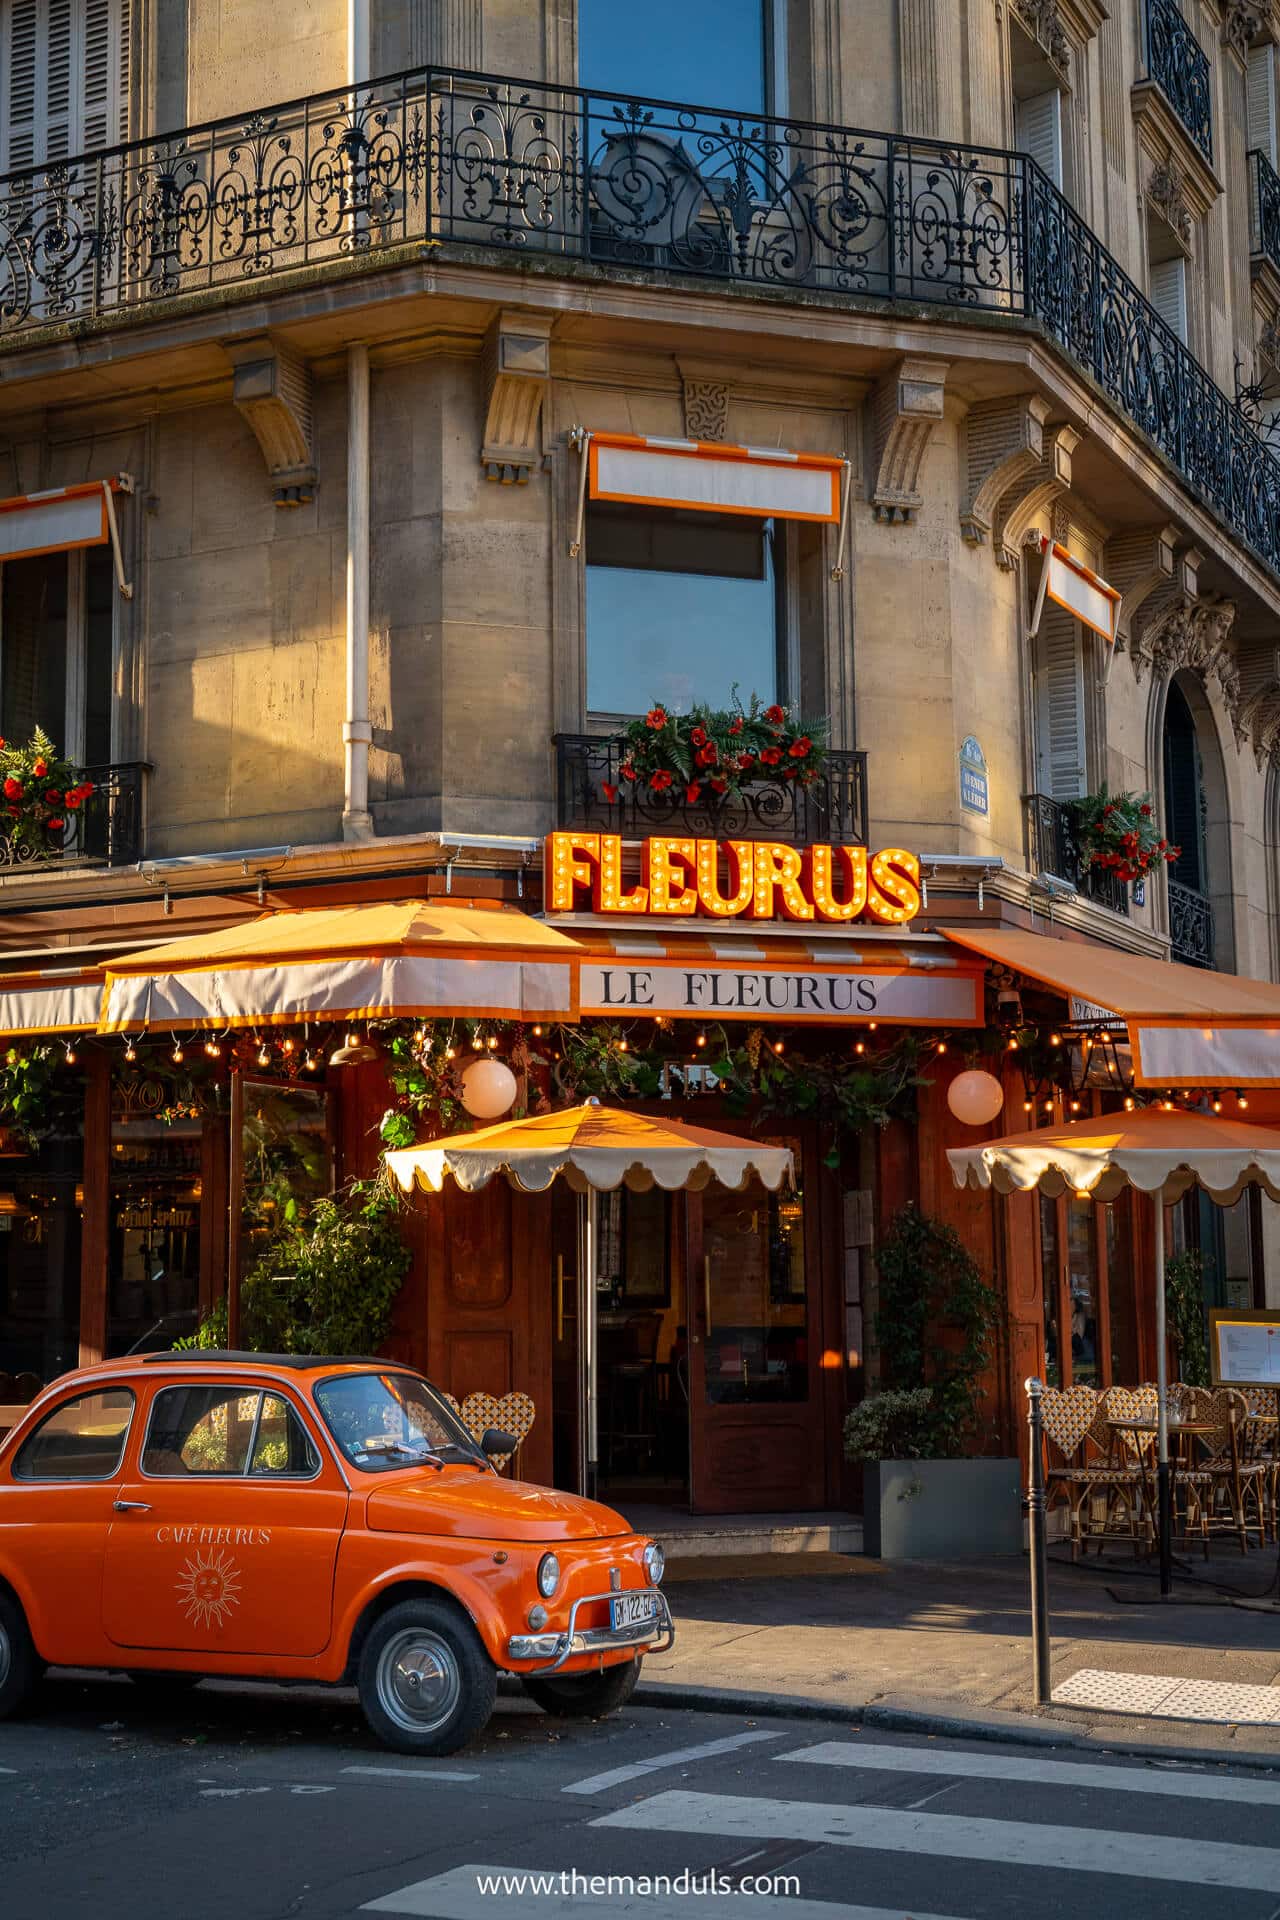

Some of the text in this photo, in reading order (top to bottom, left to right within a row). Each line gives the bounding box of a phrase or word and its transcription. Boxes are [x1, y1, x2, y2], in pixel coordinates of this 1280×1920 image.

[545, 832, 920, 924] FLEURUS
[600, 970, 878, 1012] LE FLEURUS
[199, 1526, 272, 1545] FLEURUS
